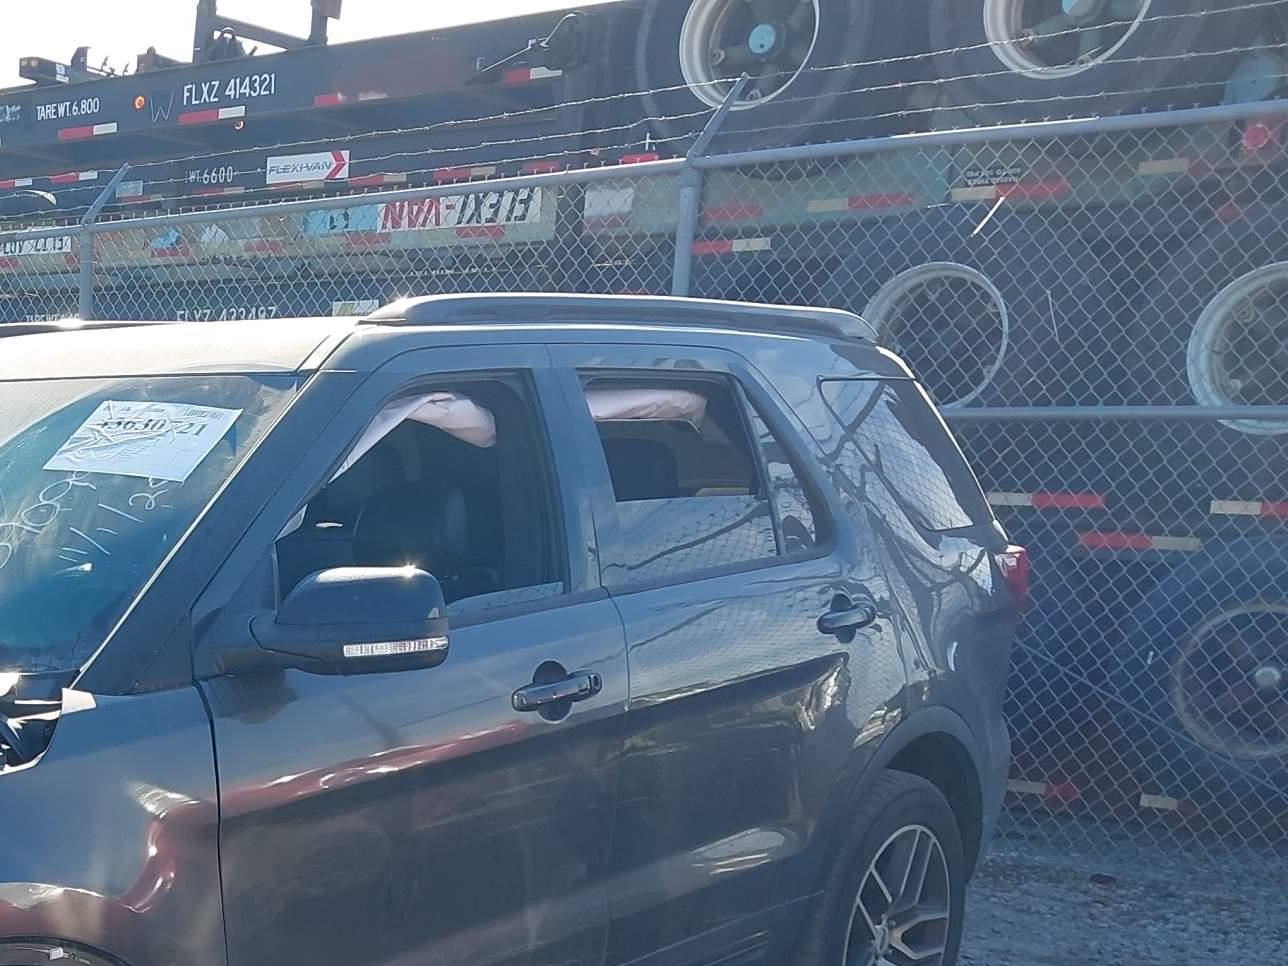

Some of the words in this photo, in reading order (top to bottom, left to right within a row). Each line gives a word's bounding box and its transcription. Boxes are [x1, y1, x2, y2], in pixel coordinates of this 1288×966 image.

[184, 80, 219, 105] FLXZ
[225, 73, 275, 99] 414321
[36, 104, 58, 121] TARE
[202, 166, 233, 184] 6600
